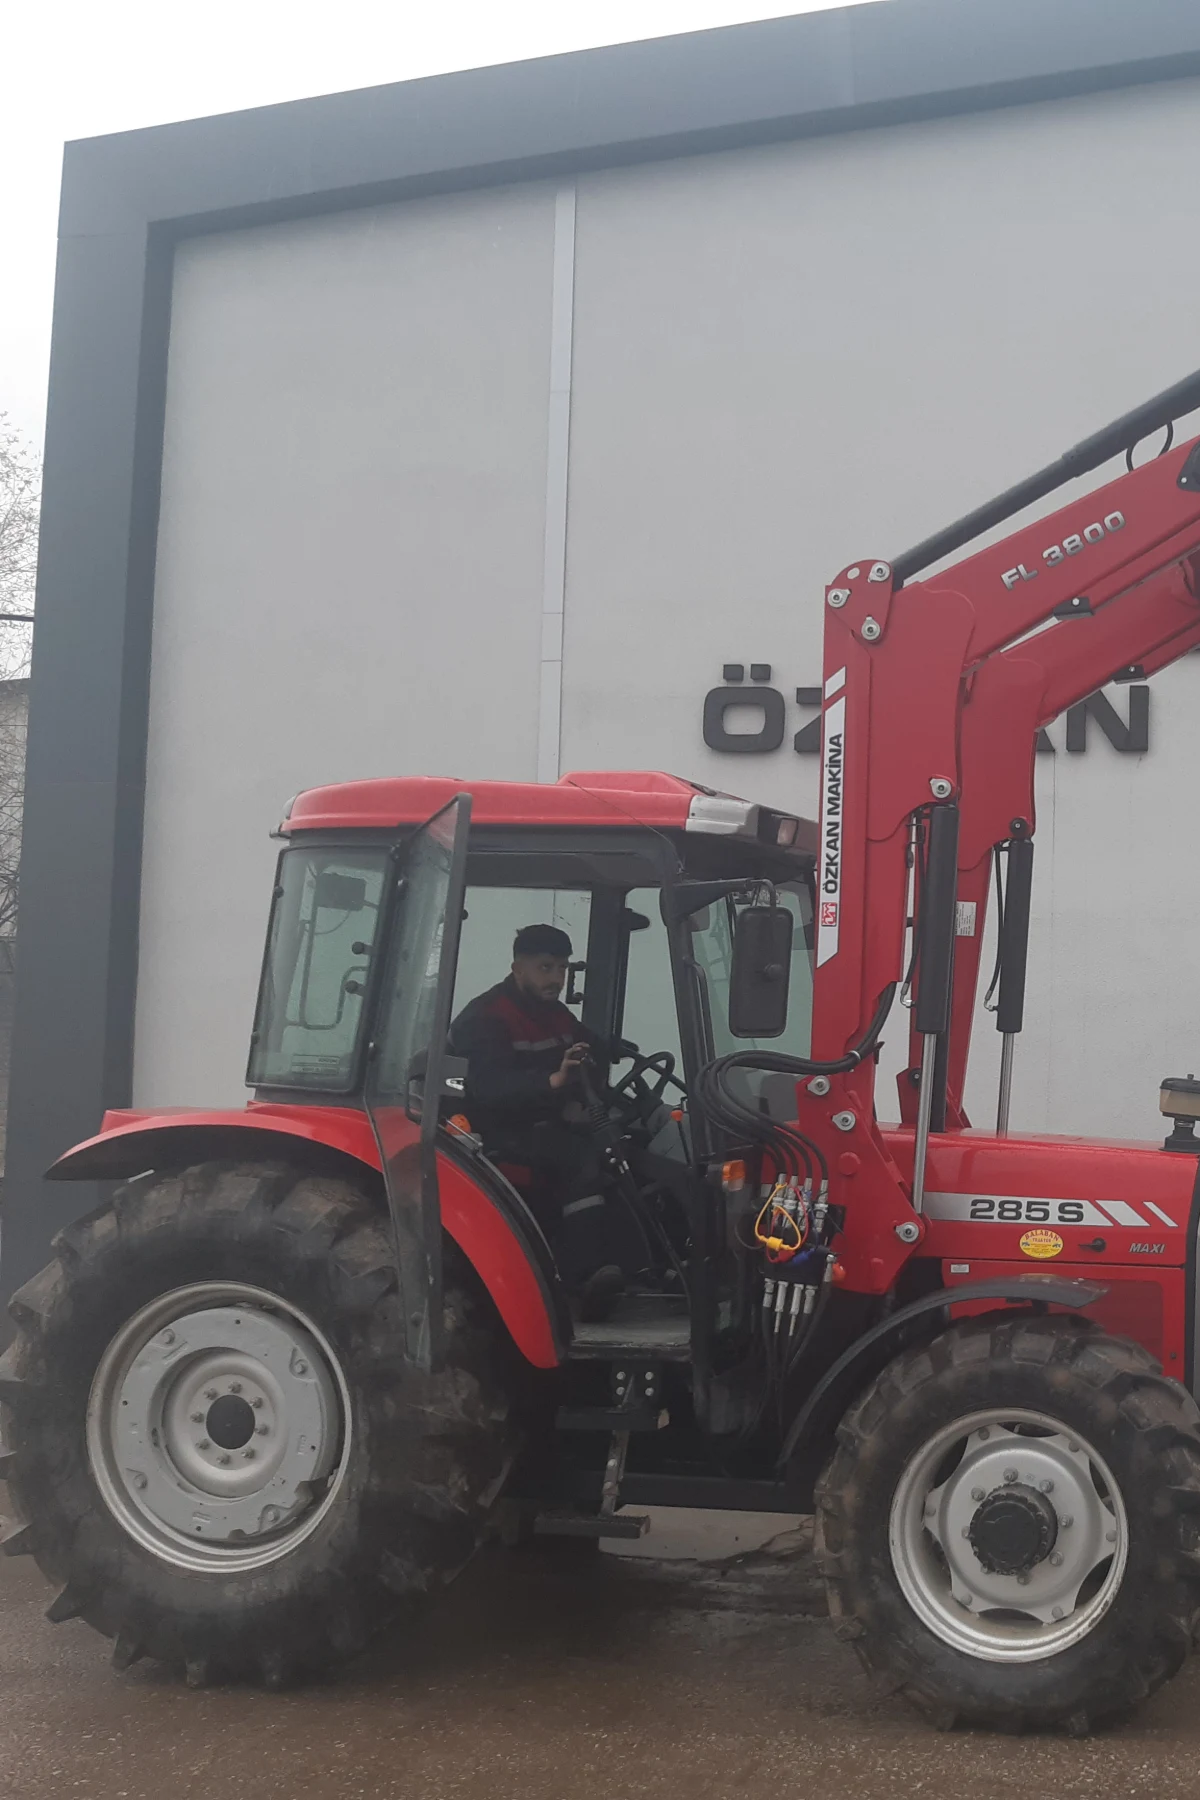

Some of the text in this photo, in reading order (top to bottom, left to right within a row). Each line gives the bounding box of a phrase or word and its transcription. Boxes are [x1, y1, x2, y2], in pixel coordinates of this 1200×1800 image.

[1000, 510, 1126, 591] FL 3800
[825, 733, 843, 816] MAKİNA
[822, 821, 840, 894] ÖZKAN
[969, 1199, 1084, 1223] 285 S
[1024, 1229, 1060, 1242] BALABAN
[1128, 1242, 1166, 1254] MAXI
